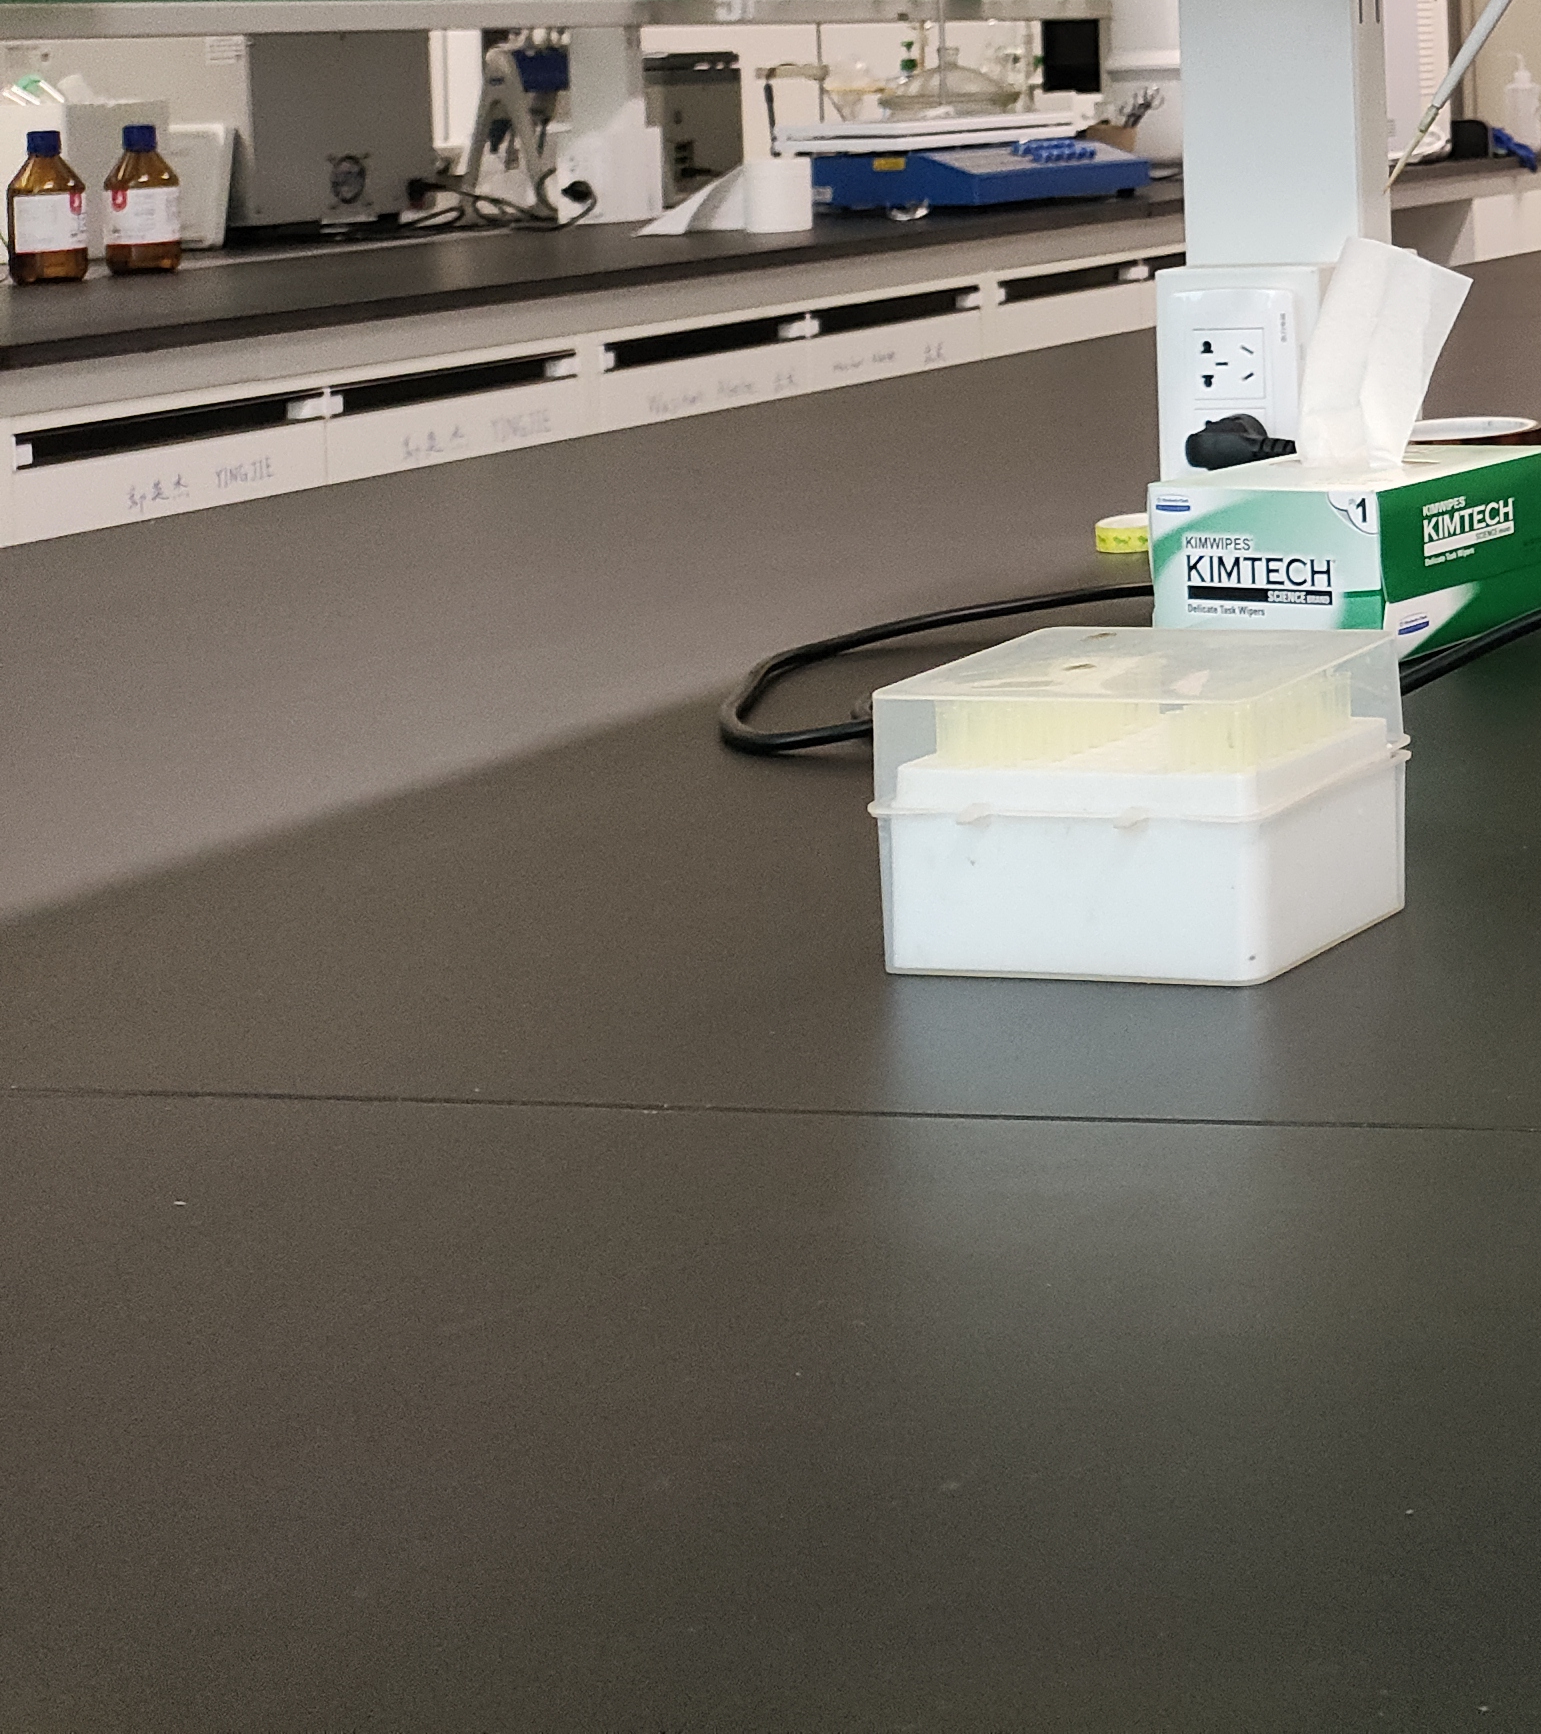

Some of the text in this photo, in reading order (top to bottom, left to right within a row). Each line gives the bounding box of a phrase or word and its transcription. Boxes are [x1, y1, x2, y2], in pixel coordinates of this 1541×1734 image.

[1356, 497, 1367, 523] 1
[1422, 496, 1466, 517] KIMWIPES
[1423, 498, 1514, 542] KIMTECH
[1185, 536, 1252, 551] KIMWIPES
[1186, 554, 1333, 588] KIMTECH
[1267, 590, 1306, 603] SCIENCE
[1187, 604, 1266, 617] Delicate Task Wipers
